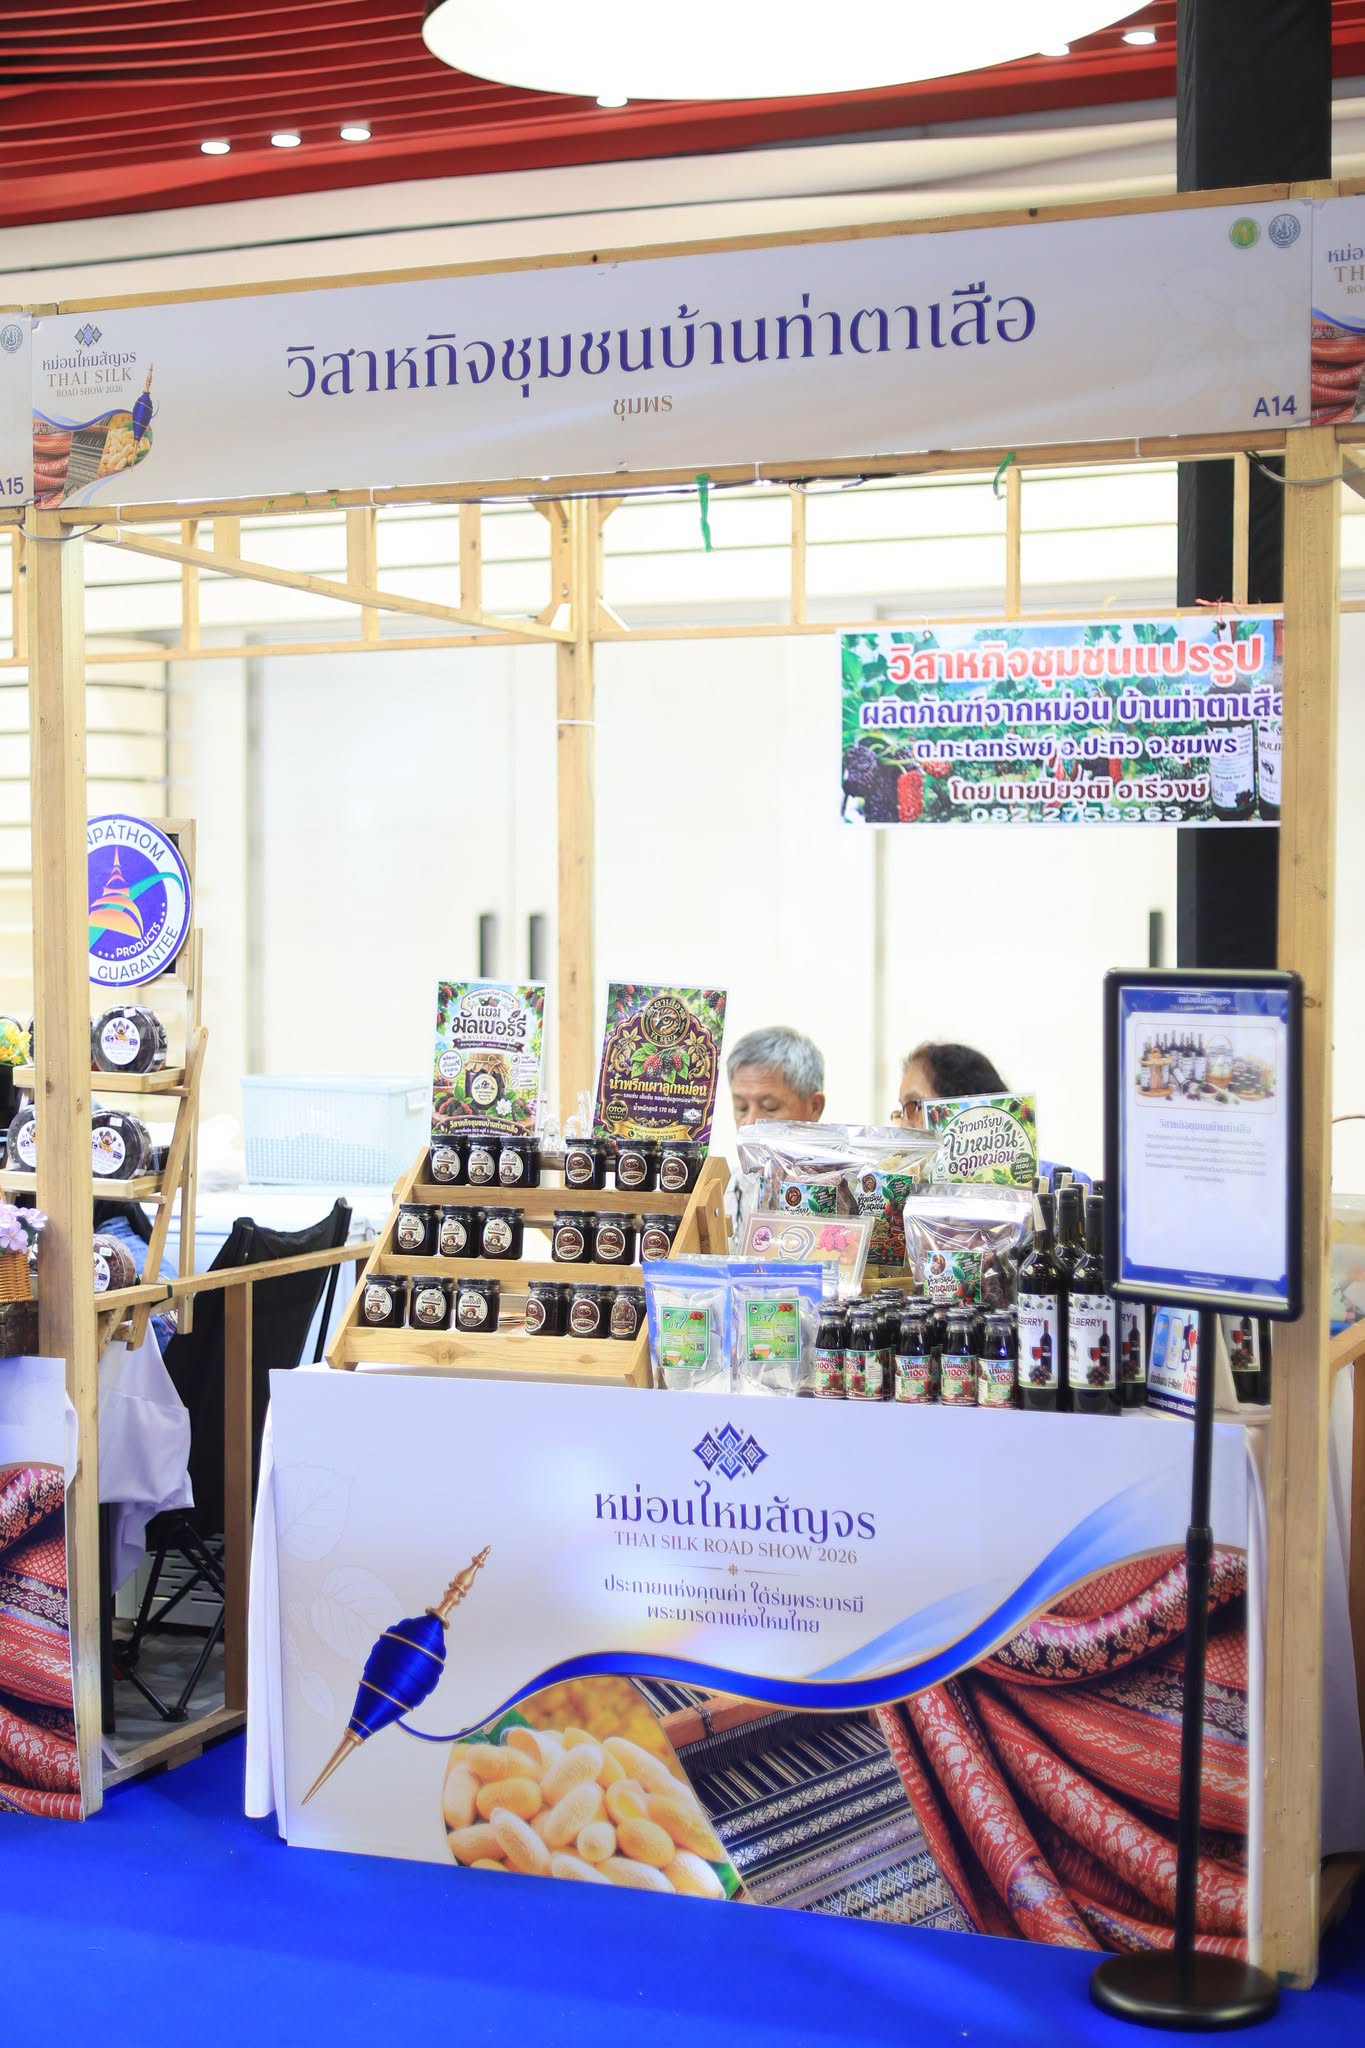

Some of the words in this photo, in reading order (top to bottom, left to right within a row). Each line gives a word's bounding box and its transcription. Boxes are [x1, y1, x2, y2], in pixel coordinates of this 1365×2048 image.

[287, 281, 1036, 398] วิสาหกิจชุมชนบ้านท่าตาเสือ
[42, 349, 136, 371] หม่อนไหมสัญจร
[47, 371, 87, 388] THAI
[95, 366, 132, 384] SILK
[56, 388, 79, 398] ROAD
[80, 386, 104, 396] SHOW
[105, 384, 123, 394] 2026
[612, 394, 673, 422] ชุมพร
[1253, 394, 1297, 418] A14
[890, 637, 1262, 688] วิสาหกิจชุมชนแปรรูป
[863, 692, 1109, 725] ผลิตภัณฑ์จากหม่อน
[917, 735, 1053, 758] ต.ทะเลทรัพย์
[1061, 735, 1139, 756] อ.ปะทิว
[1148, 736, 1237, 760] จ.ชุมพร
[951, 779, 991, 800] โดย
[999, 779, 1110, 805] นายปิยวุฒิ
[1118, 777, 1208, 799] อารีวงษ์
[971, 805, 1184, 822] 082-2753363
[98, 926, 178, 980] GUARANTEE
[116, 921, 161, 958] PRODUCTS
[452, 1009, 527, 1038] มัลเบอร์รี
[477, 1007, 501, 1018] แยม
[609, 1073, 707, 1097] น้ำพริกเผาลูกหม่อน
[958, 1115, 1003, 1134] ข้าวเกรียบ
[944, 1127, 1018, 1162] ใบหม่อน
[949, 1162, 958, 1174] &
[958, 1150, 1015, 1177] ลูกหม่อน
[595, 1480, 876, 1544] หม่อนไหมสัญจร
[614, 1530, 656, 1548] THAI
[661, 1534, 699, 1552] SILK
[704, 1538, 753, 1556] ROAD
[758, 1542, 813, 1561] SHOW
[818, 1548, 858, 1565] 2026
[604, 1574, 746, 1605] ประกายแห่งคุณค่า
[751, 1582, 864, 1614] ใต้ร่มพระบารมี
[647, 1605, 820, 1634] พระมารดาแห่งไหมไทย
